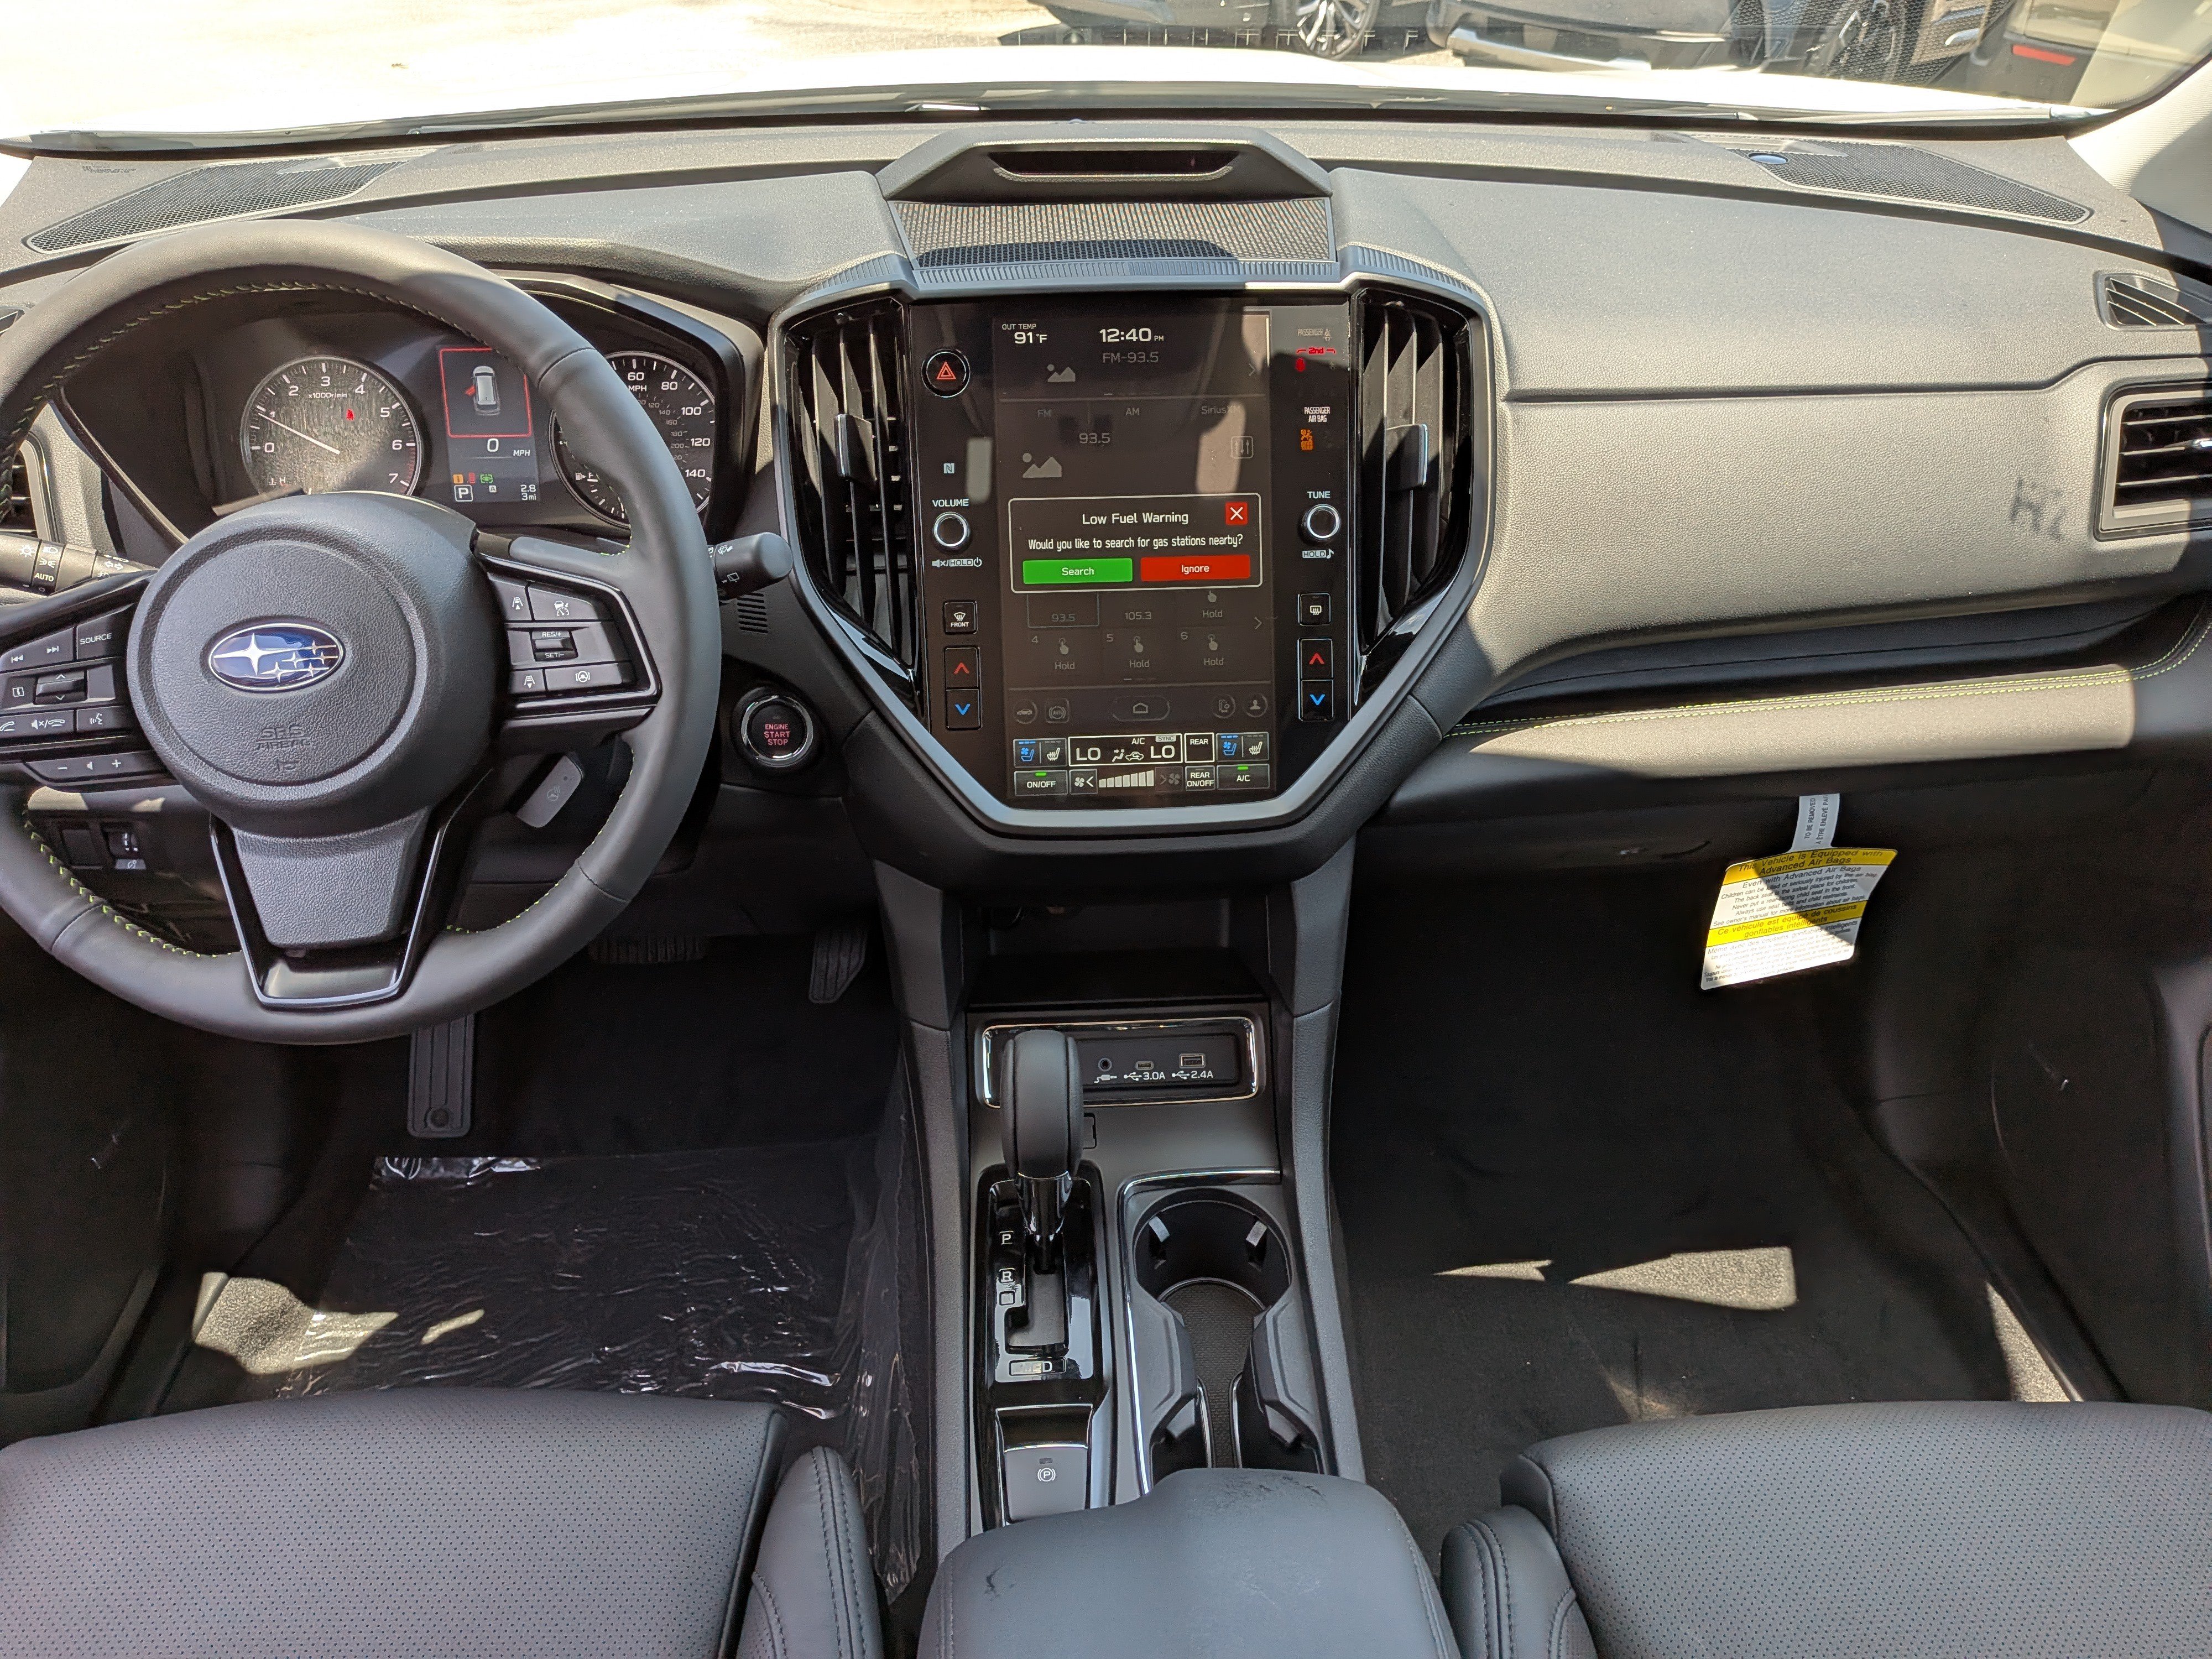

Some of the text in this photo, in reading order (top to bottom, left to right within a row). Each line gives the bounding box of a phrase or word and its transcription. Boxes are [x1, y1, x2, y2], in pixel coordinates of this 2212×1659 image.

[1099, 327, 1152, 342] 12:40
[320, 376, 330, 386] 3
[627, 372, 645, 380] 60
[289, 385, 299, 396] 2
[354, 384, 366, 394] 4
[661, 382, 678, 390] 80
[380, 407, 390, 418] 5
[681, 406, 702, 415] 100
[1037, 409, 1051, 418] FM
[1125, 407, 1140, 416] AM
[1201, 405, 1241, 415] SiriusXM
[1304, 406, 1331, 415] PASSENGER
[690, 437, 711, 446] 120
[1078, 432, 1111, 444] 93.5
[264, 442, 275, 453] 0
[392, 440, 403, 450] 6
[487, 438, 499, 452] 0
[388, 473, 399, 483] 7
[685, 469, 706, 478] 140
[520, 484, 536, 492] 2.8
[458, 488, 469, 499] P
[1307, 491, 1331, 499] TUNE
[932, 498, 969, 507] VOLUME
[1082, 512, 1189, 525] Low Fuel Warning
[1028, 534, 1244, 552] Would you like to search for gas stations nearby?
[1062, 567, 1094, 576] Search
[1181, 565, 1210, 575] Ignore
[34, 573, 54, 582] AUTO
[1051, 613, 1076, 622] 93.5
[1125, 611, 1152, 620] 105.3
[80, 633, 112, 645] SOURCE
[1107, 634, 1114, 642] 5
[1181, 632, 1188, 640] 6
[1055, 661, 1076, 670] Hold
[1129, 660, 1150, 668] Hold
[1076, 747, 1101, 760] LO
[1150, 745, 1175, 759] LO
[1804, 831, 1812, 839] TO
[1808, 797, 1816, 824] REMOVED
[1739, 863, 1757, 872] This
[1761, 855, 1794, 867] Vehicle
[1810, 849, 1858, 859] Equipped
[1759, 857, 1852, 875] Advanced Air Bags
[1743, 880, 1762, 889] Even
[1765, 875, 1781, 884] with
[1783, 868, 1824, 880] Advanced
[1721, 891, 1743, 900] Children
[1732, 921, 1764, 932] véhicule
[1823, 904, 1858, 915] coussins
[1786, 916, 1828, 929] intelligents
[1142, 1071, 1166, 1081] 3.0A
[1191, 1070, 1214, 1079] 2.4A
[1001, 1234, 1011, 1245] P
[1001, 1271, 1013, 1281] R
[1042, 1361, 1052, 1373] D
